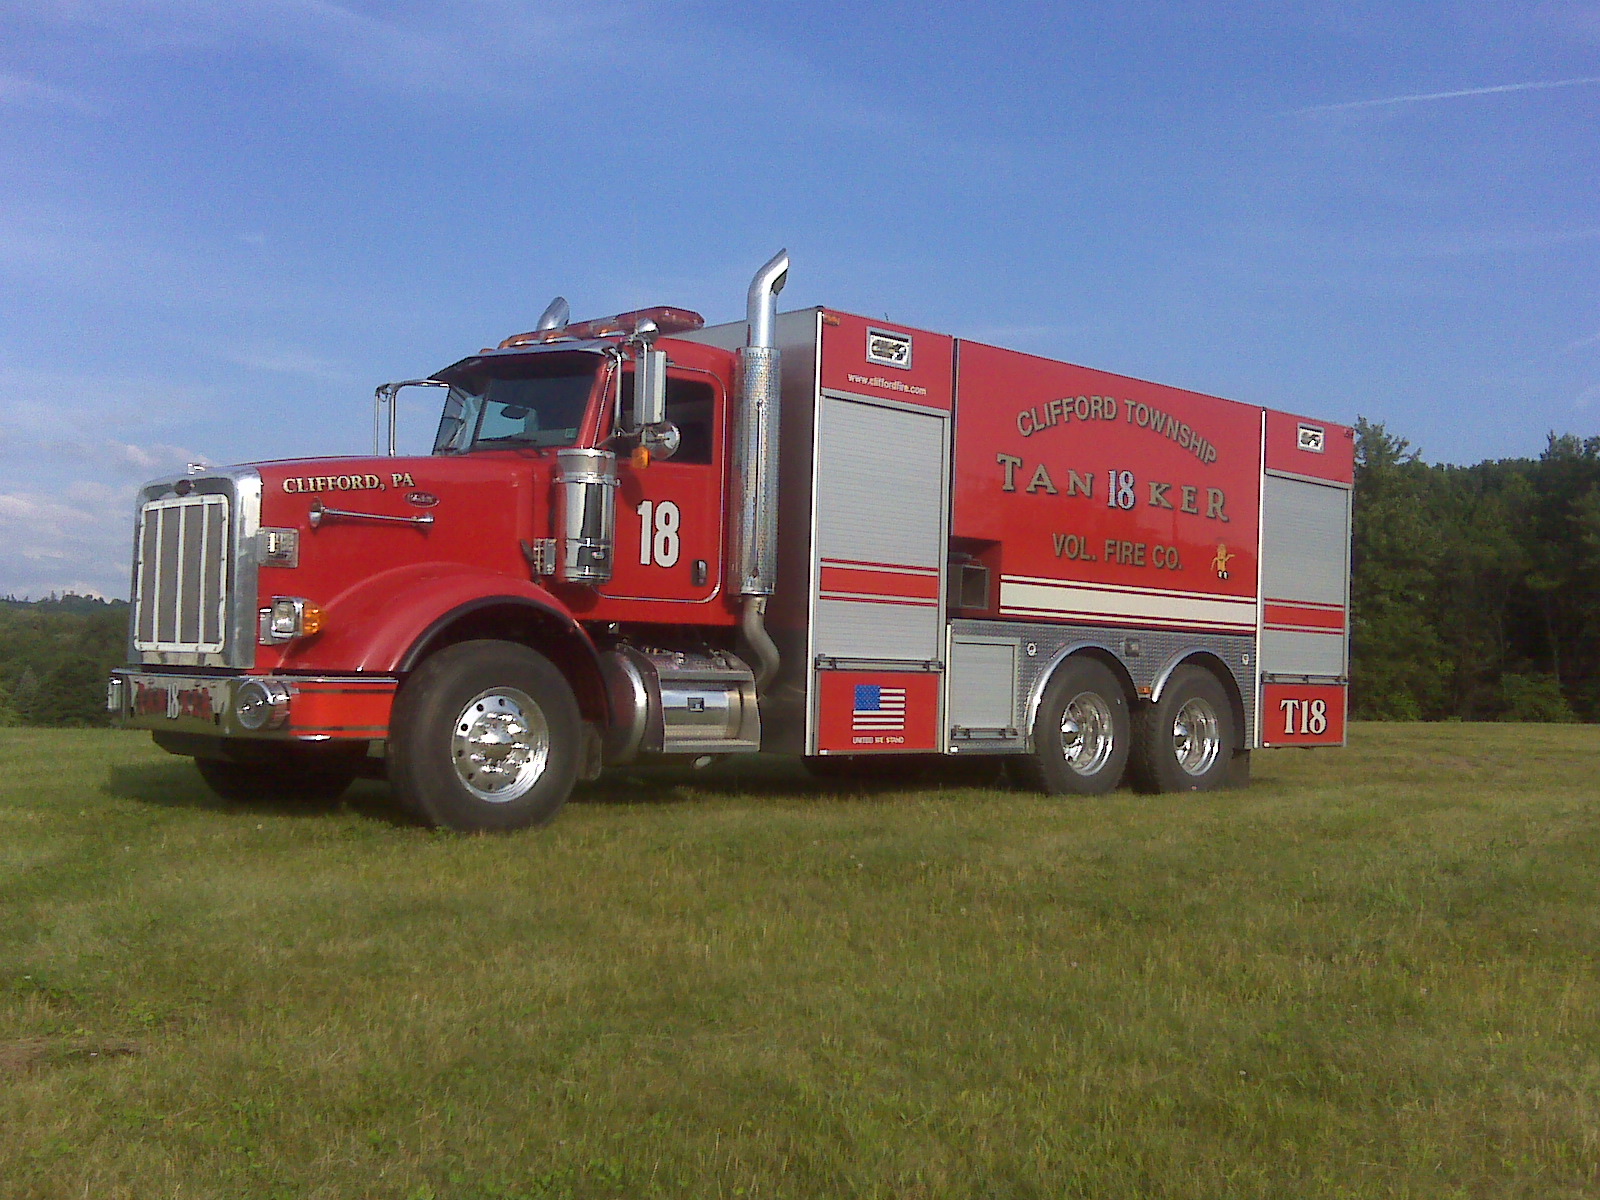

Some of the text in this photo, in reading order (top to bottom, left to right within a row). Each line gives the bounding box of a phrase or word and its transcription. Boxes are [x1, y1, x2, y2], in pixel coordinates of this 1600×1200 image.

[847, 373, 927, 396] www.cliffordfire.com
[1016, 395, 1217, 464] CLIFFORD TOWNSHIP
[282, 472, 415, 494] CLIFFORD, PA
[1107, 469, 1136, 510] 18
[637, 500, 680, 568] 18
[1052, 532, 1183, 570] VOL. FIRE CO.
[166, 682, 180, 719] 18
[1279, 699, 1327, 735] T18
